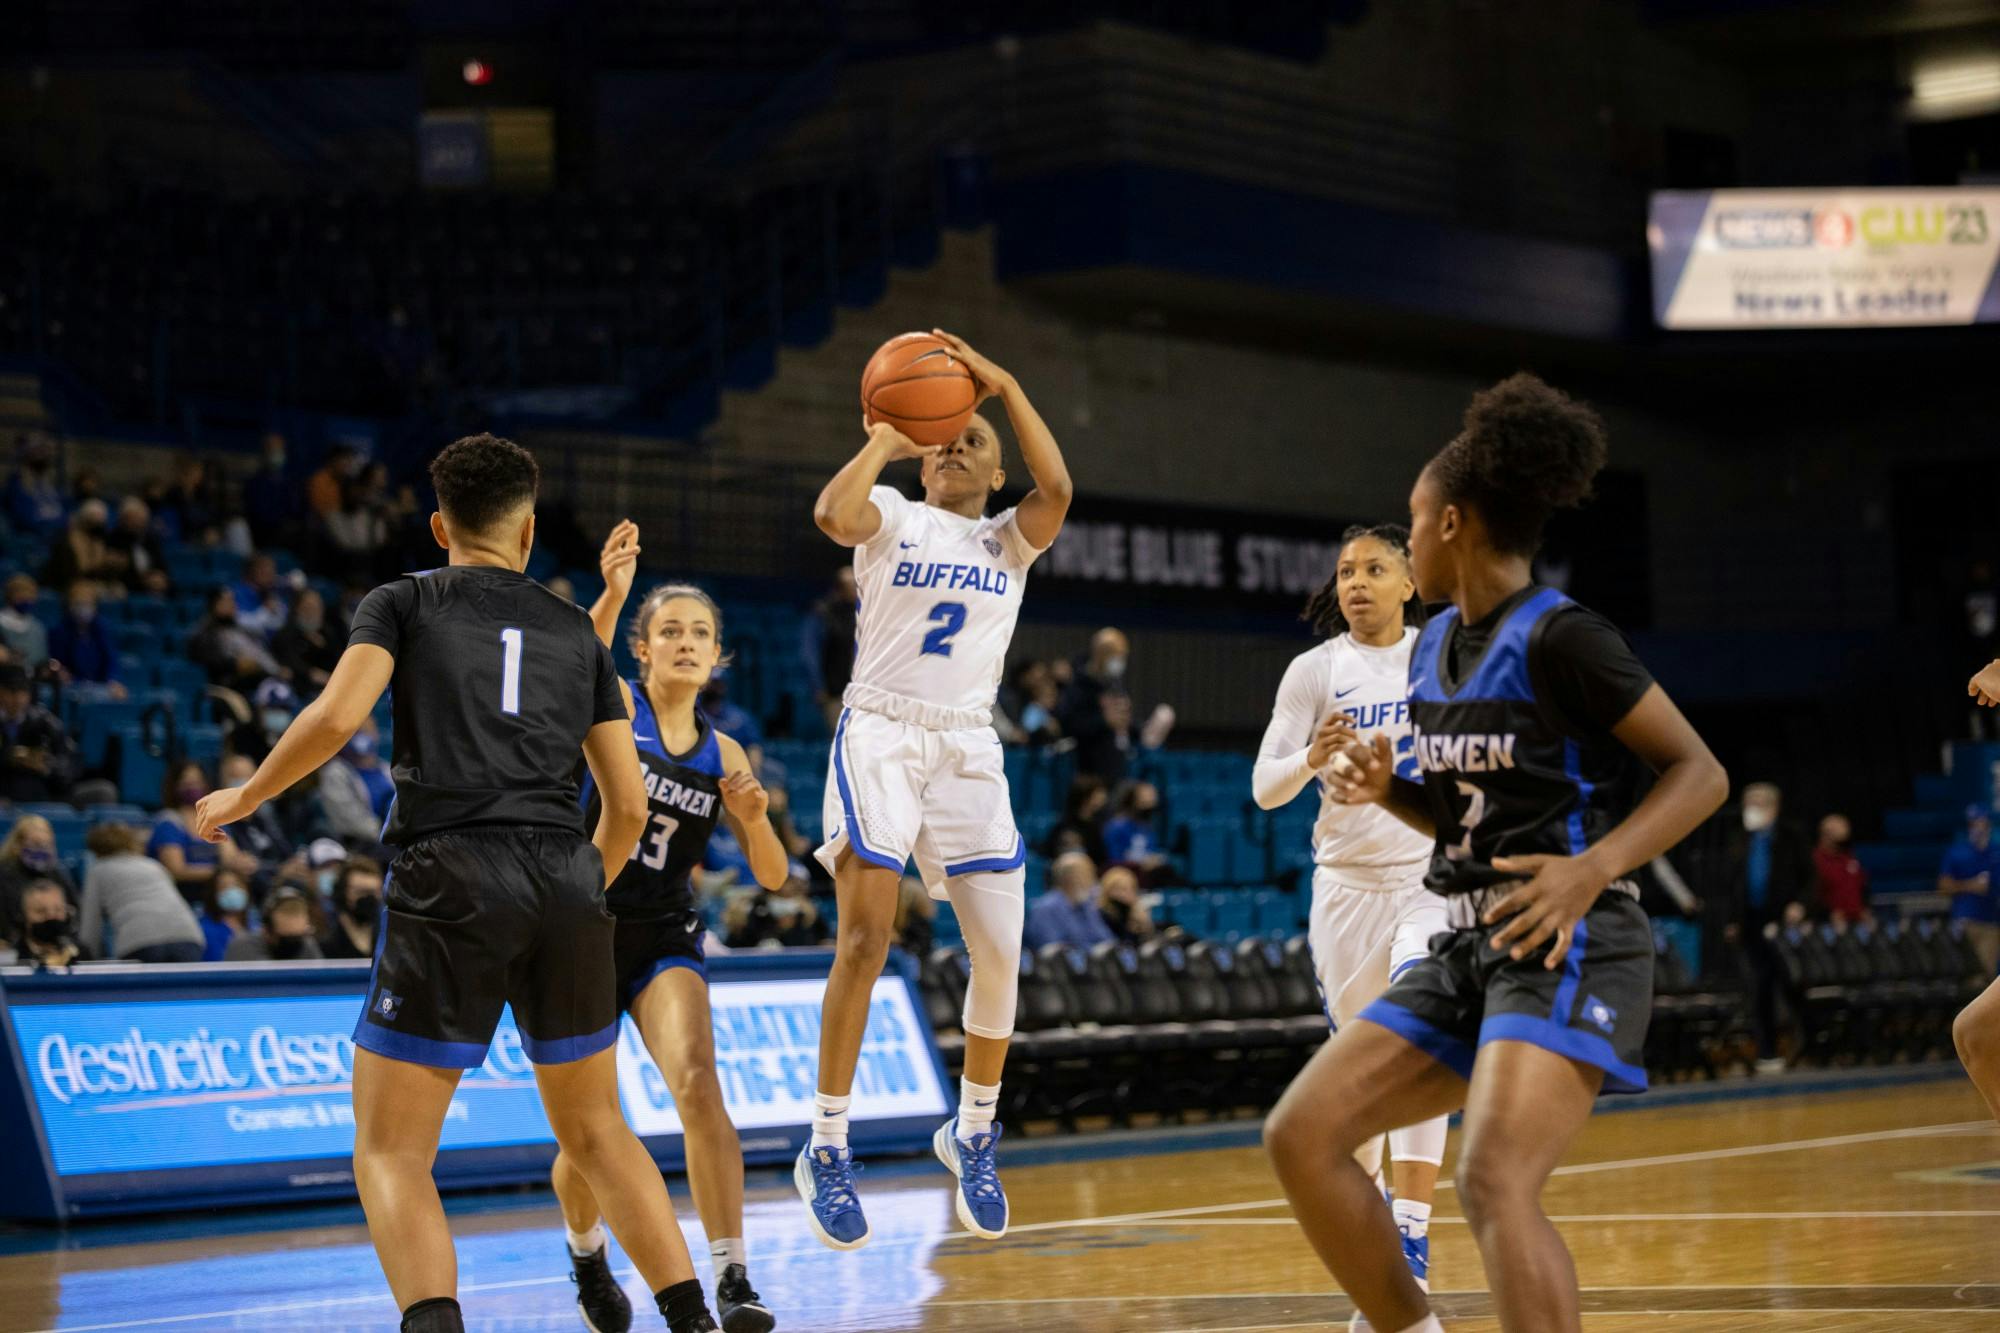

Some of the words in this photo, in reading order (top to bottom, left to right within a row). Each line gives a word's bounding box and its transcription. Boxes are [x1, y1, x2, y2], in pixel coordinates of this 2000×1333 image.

[1733, 291, 1822, 314] News
[1835, 286, 1949, 313] Leader
[892, 561, 1008, 596] BUFFALO
[1130, 525, 1223, 588] BLUE
[919, 601, 968, 657] 2
[501, 626, 523, 716] 1
[1343, 701, 1412, 730] BUFF
[38, 1027, 249, 1105] Aesthetic
